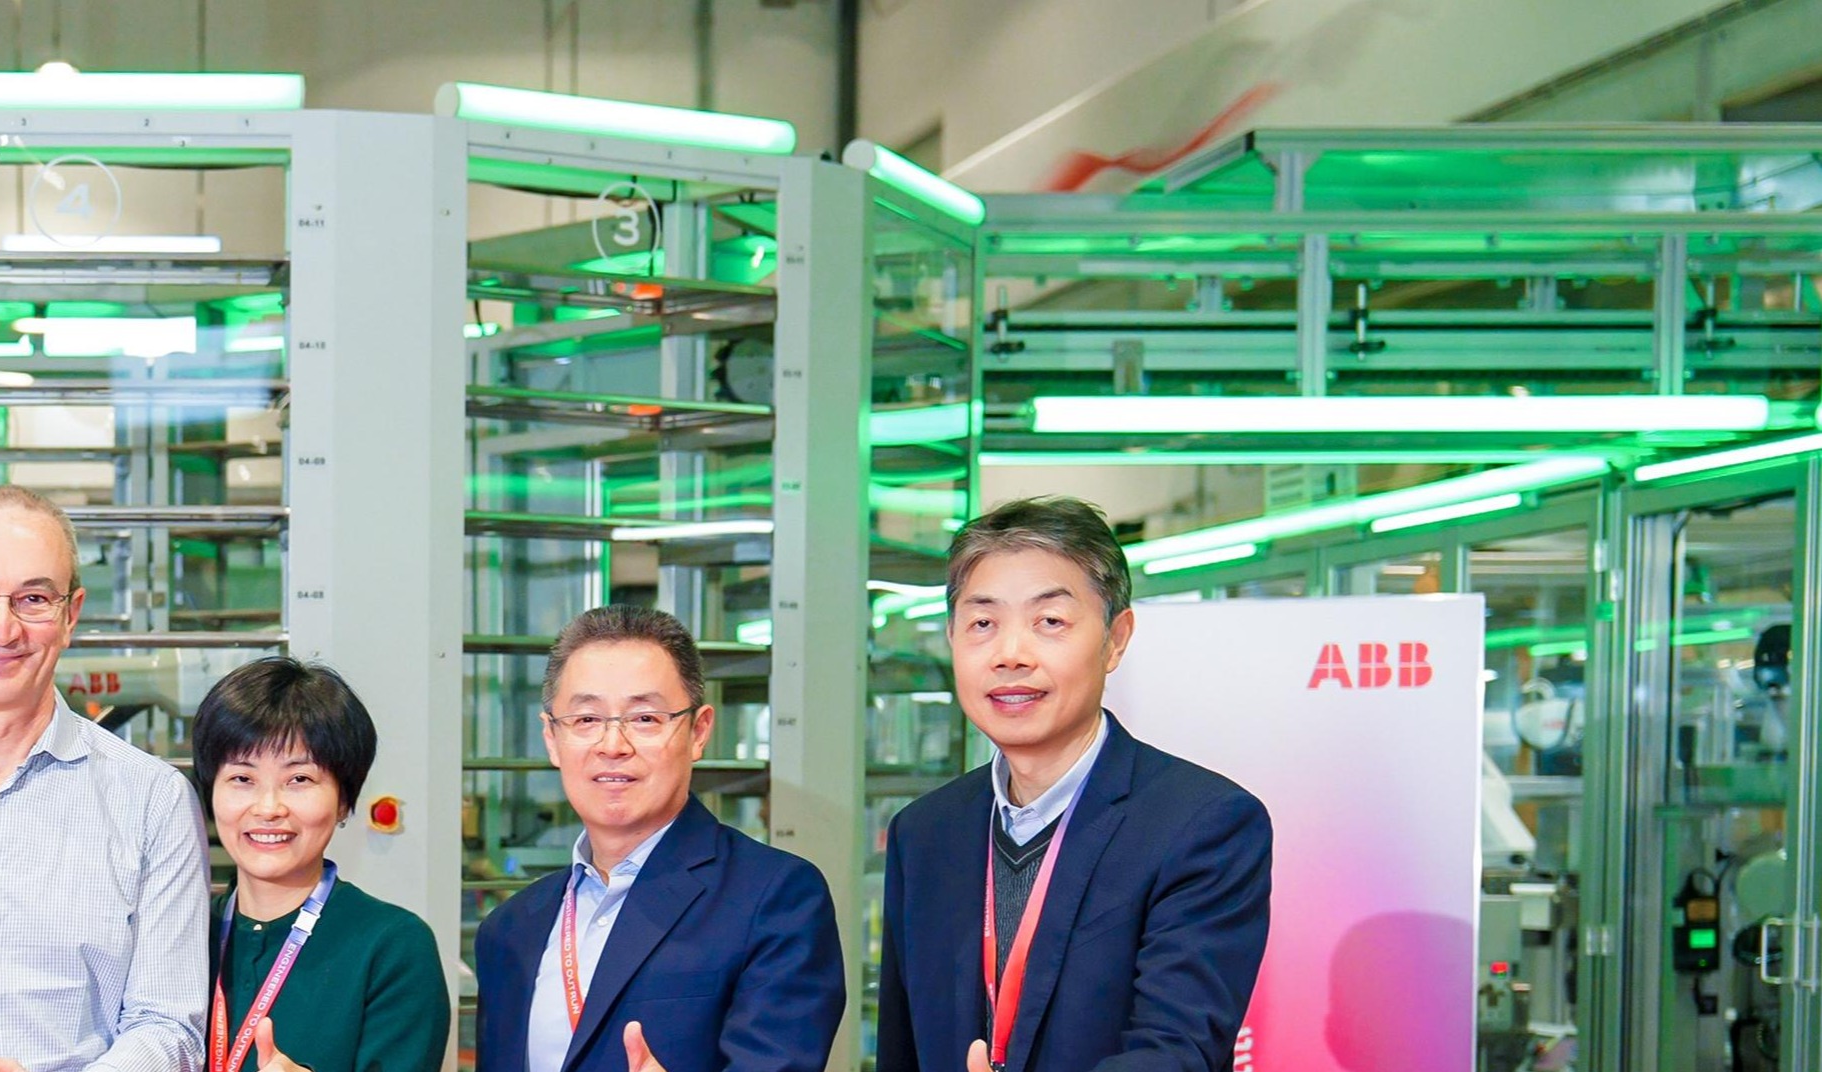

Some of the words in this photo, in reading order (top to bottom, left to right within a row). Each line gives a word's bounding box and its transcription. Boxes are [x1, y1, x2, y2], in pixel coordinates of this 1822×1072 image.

[55, 184, 94, 218] 4
[298, 219, 325, 227] 04-11
[613, 207, 639, 246] 3
[68, 672, 120, 696] ABB
[1308, 643, 1432, 689] ABB
[258, 943, 298, 1011] ENGINEERED
[564, 953, 573, 968] TO
[565, 969, 580, 1015] OUTRUN
[215, 1001, 224, 1072] ENGINEERED
[249, 1013, 261, 1027] TO
